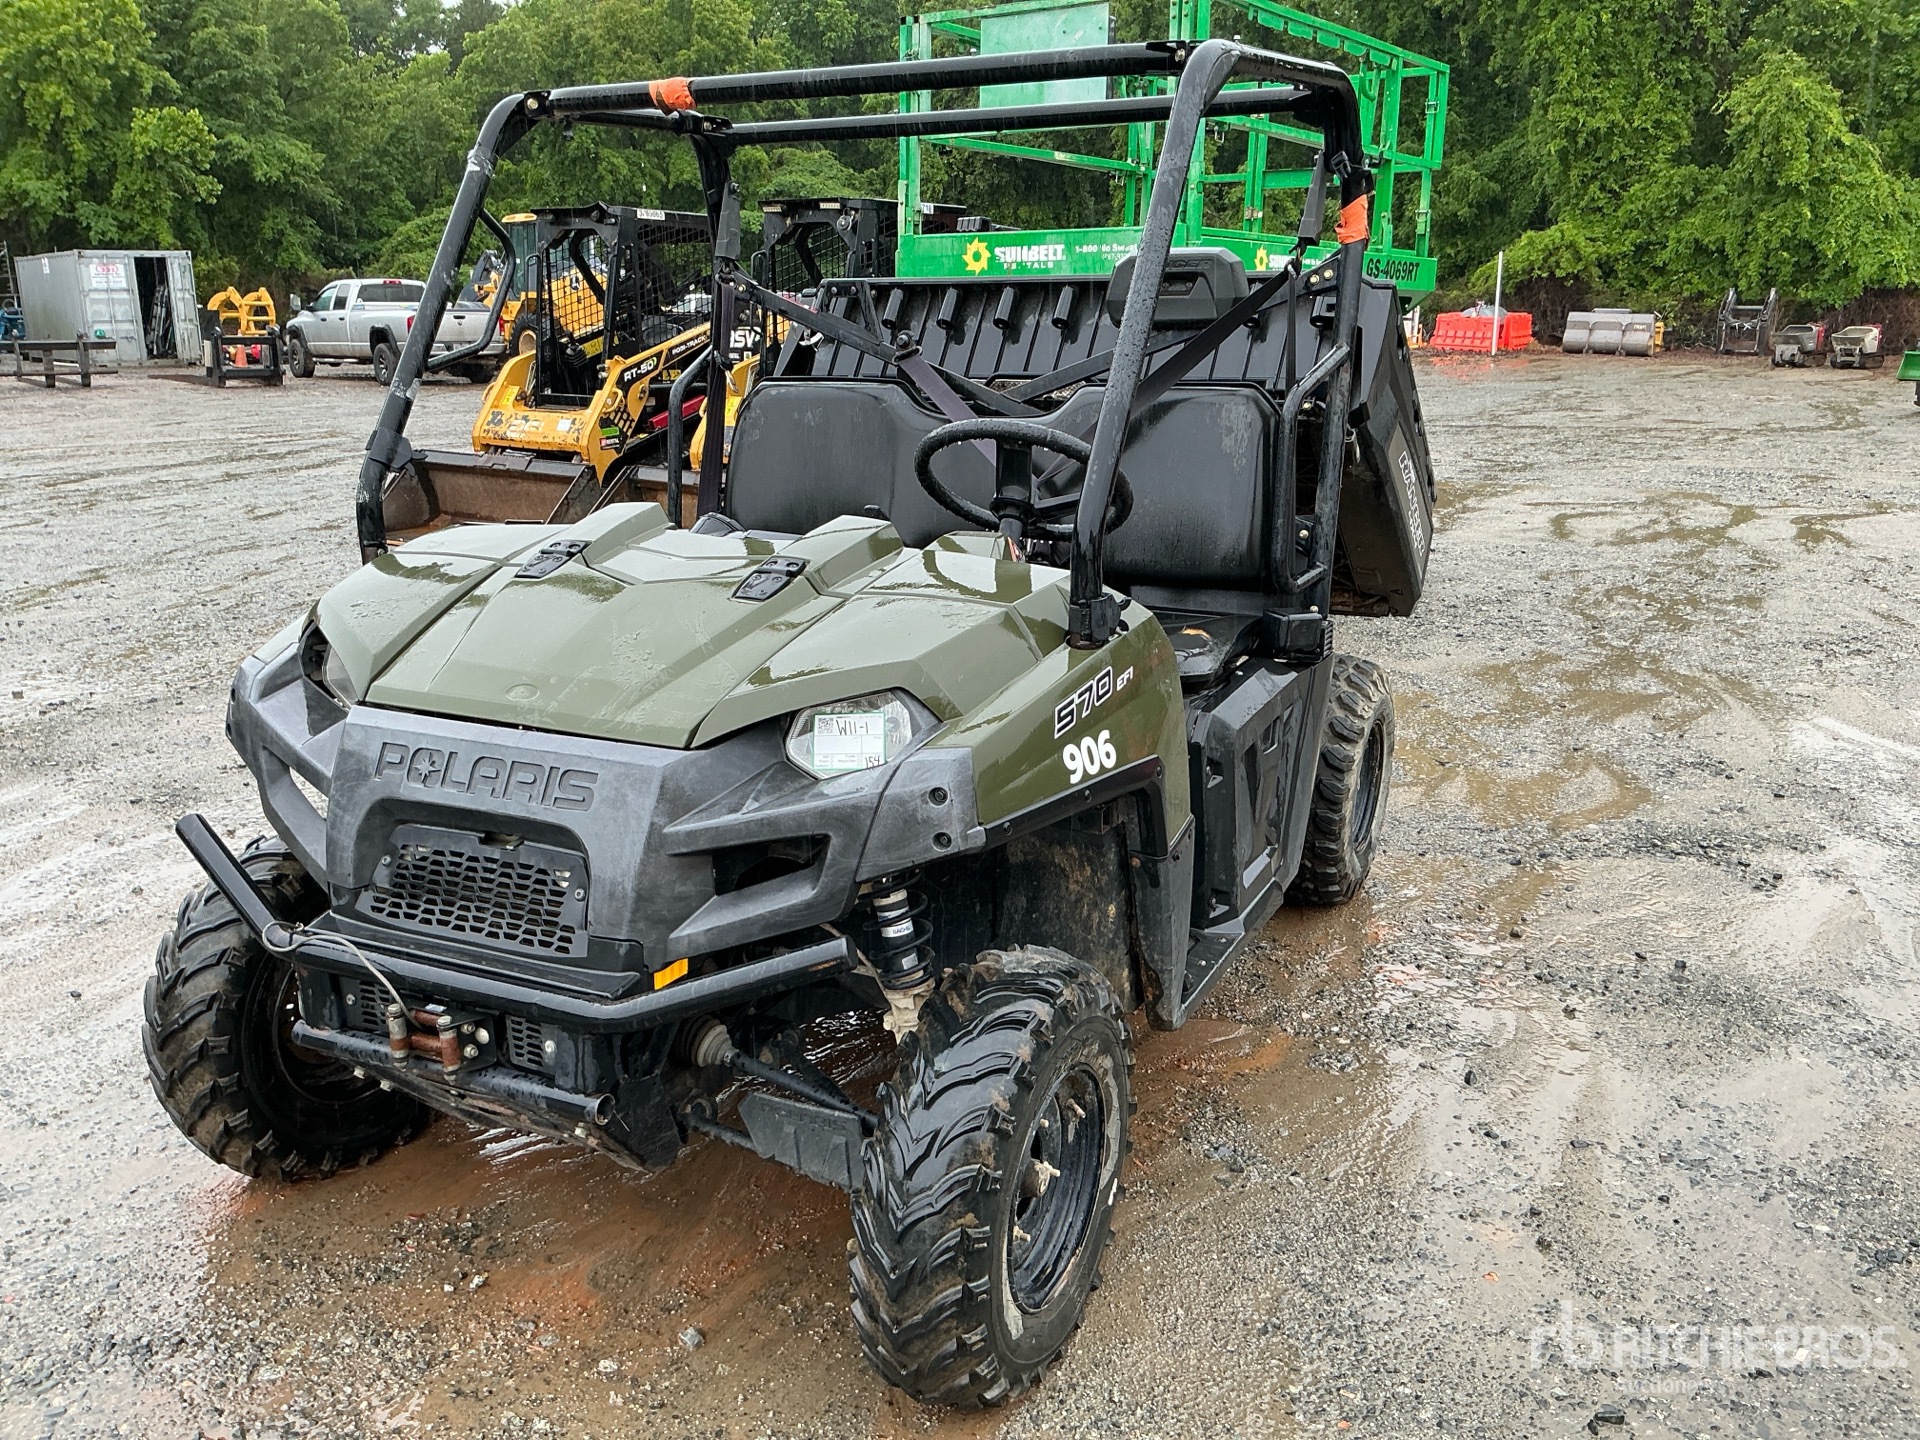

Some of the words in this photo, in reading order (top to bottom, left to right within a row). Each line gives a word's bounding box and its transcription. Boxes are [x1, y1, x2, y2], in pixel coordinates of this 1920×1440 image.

[1366, 257, 1420, 282] GS-4069RT
[624, 359, 655, 382] RT-50
[1054, 665, 1113, 740] 570
[1116, 665, 1133, 692] EFI
[373, 741, 599, 811] POLARIS
[1062, 729, 1117, 785] 906
